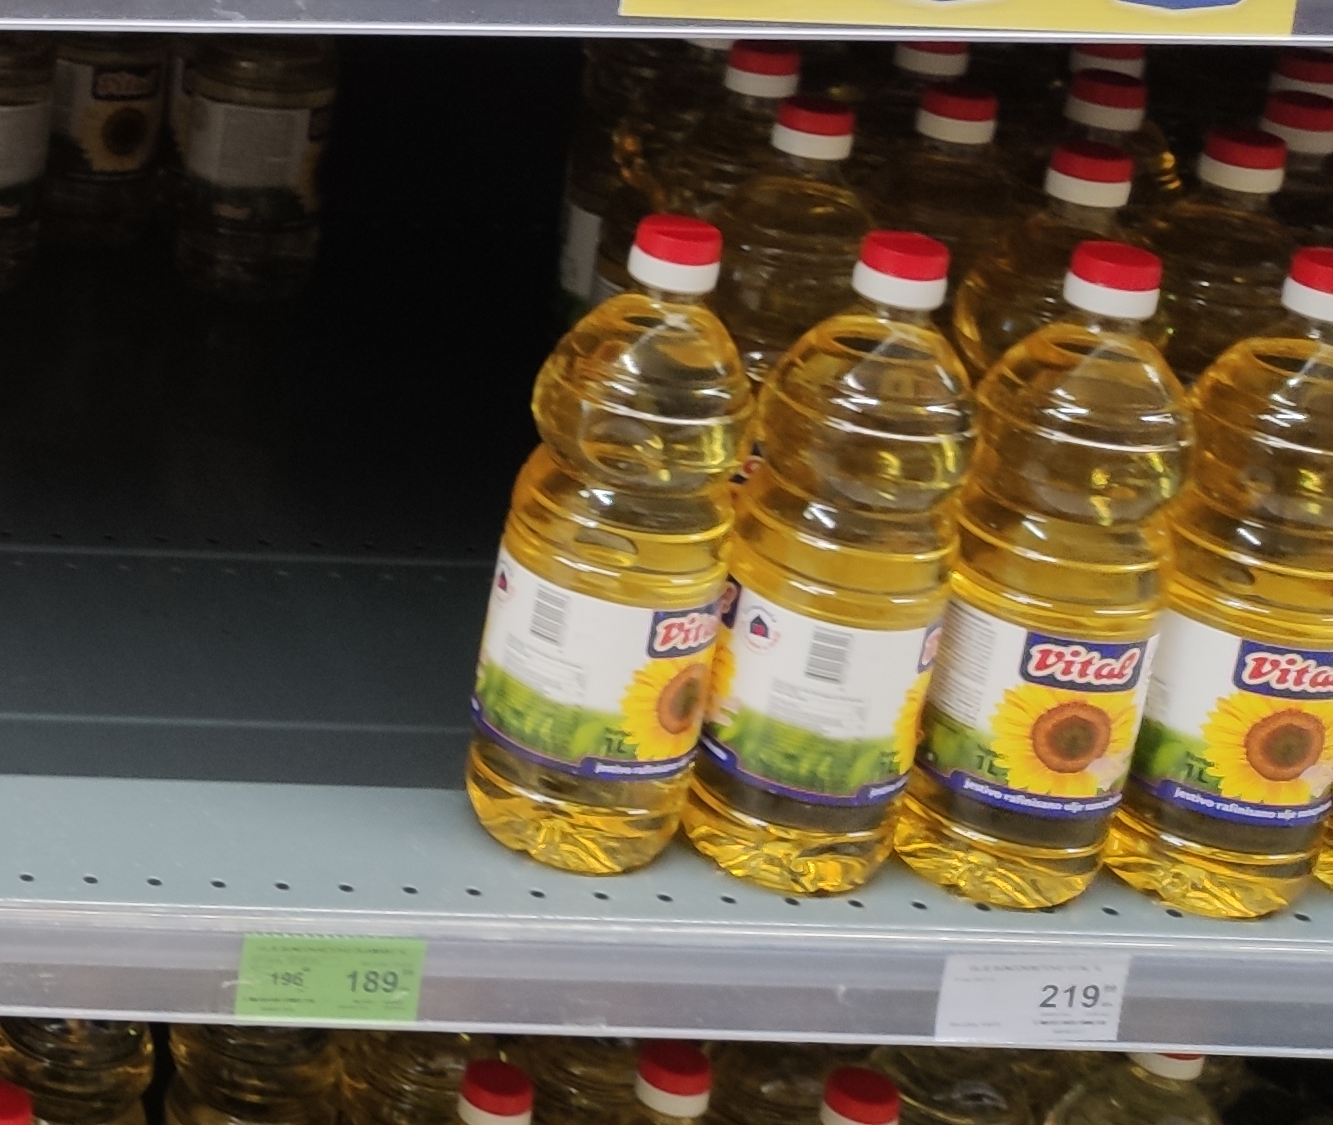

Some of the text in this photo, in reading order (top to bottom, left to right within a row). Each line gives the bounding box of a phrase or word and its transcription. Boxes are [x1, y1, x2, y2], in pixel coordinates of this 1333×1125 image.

[1035, 648, 1137, 681] Vital
[1248, 656, 1333, 690] Vita
[347, 970, 399, 993] 189
[1039, 984, 1101, 1008] 219
